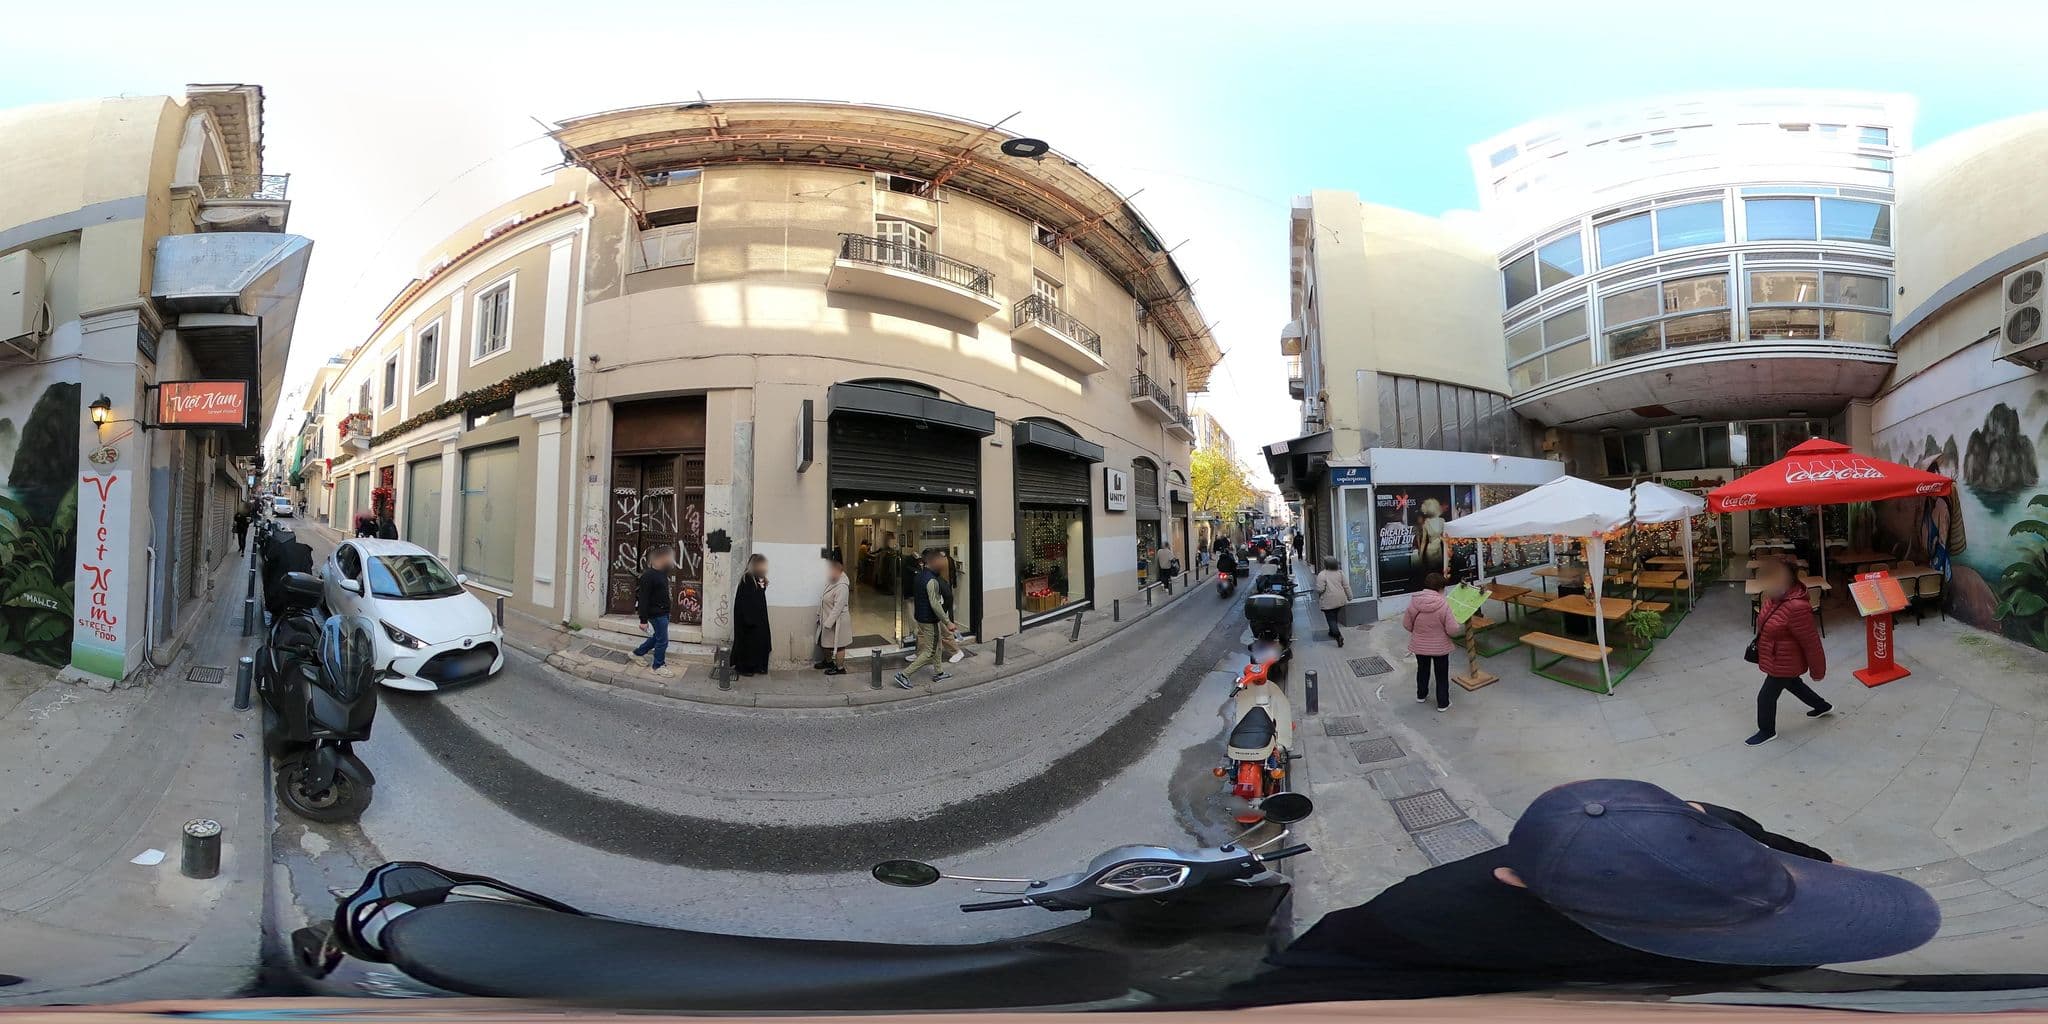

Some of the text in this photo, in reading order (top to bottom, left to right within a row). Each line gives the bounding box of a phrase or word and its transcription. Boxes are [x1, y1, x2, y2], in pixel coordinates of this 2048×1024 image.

[201, 392, 242, 409] Nam
[1110, 493, 1126, 502] UNITY
[1381, 535, 1402, 546] NIGHT
[79, 619, 113, 632] STREET
[94, 631, 117, 642] FOOD
